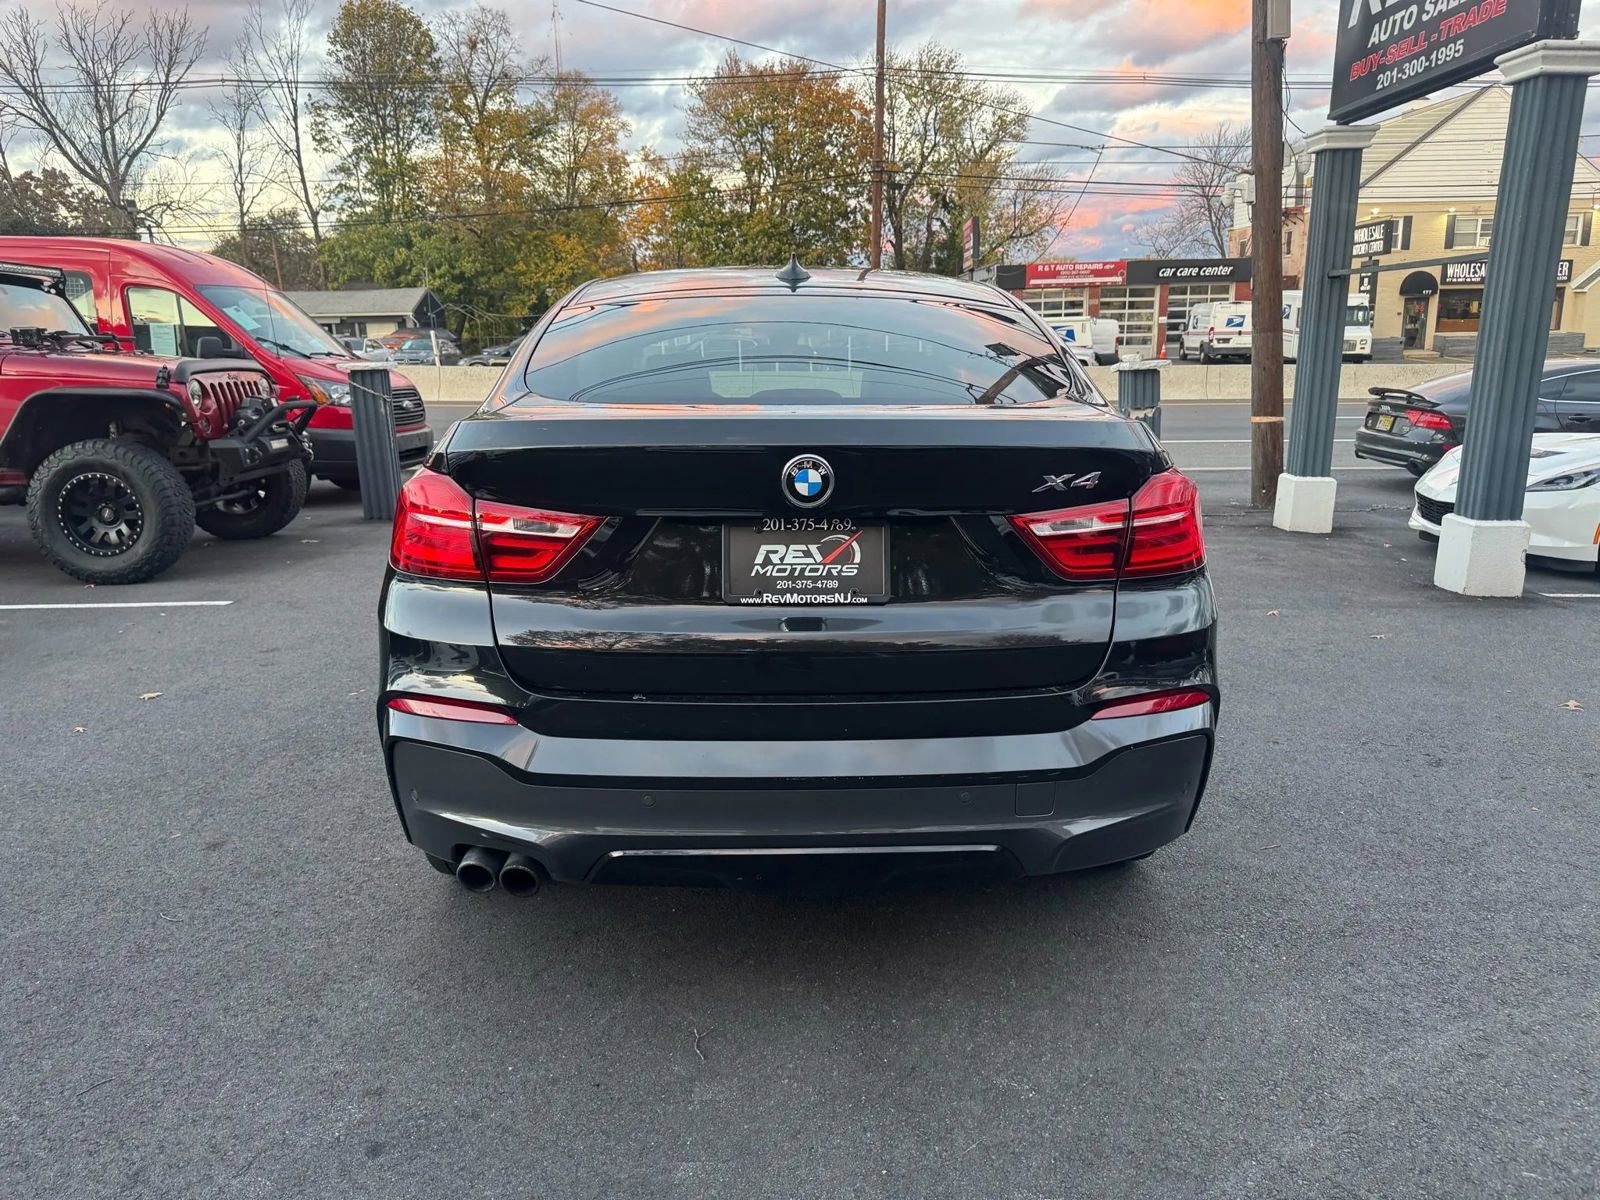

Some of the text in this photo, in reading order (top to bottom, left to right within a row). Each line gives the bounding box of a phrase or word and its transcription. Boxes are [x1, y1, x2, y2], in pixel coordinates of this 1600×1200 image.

[1368, 4, 1418, 49] AUTO
[1440, 0, 1507, 41] TRADE
[1376, 39, 1465, 90] 201-300-1995
[1354, 224, 1385, 244] WHOLESALE
[1159, 265, 1233, 277] car care center
[790, 460, 828, 477] BMW
[1031, 471, 1102, 493] X4
[754, 536, 848, 564] REV
[751, 564, 859, 577] MOTORS
[776, 580, 839, 589] 201-375-4789
